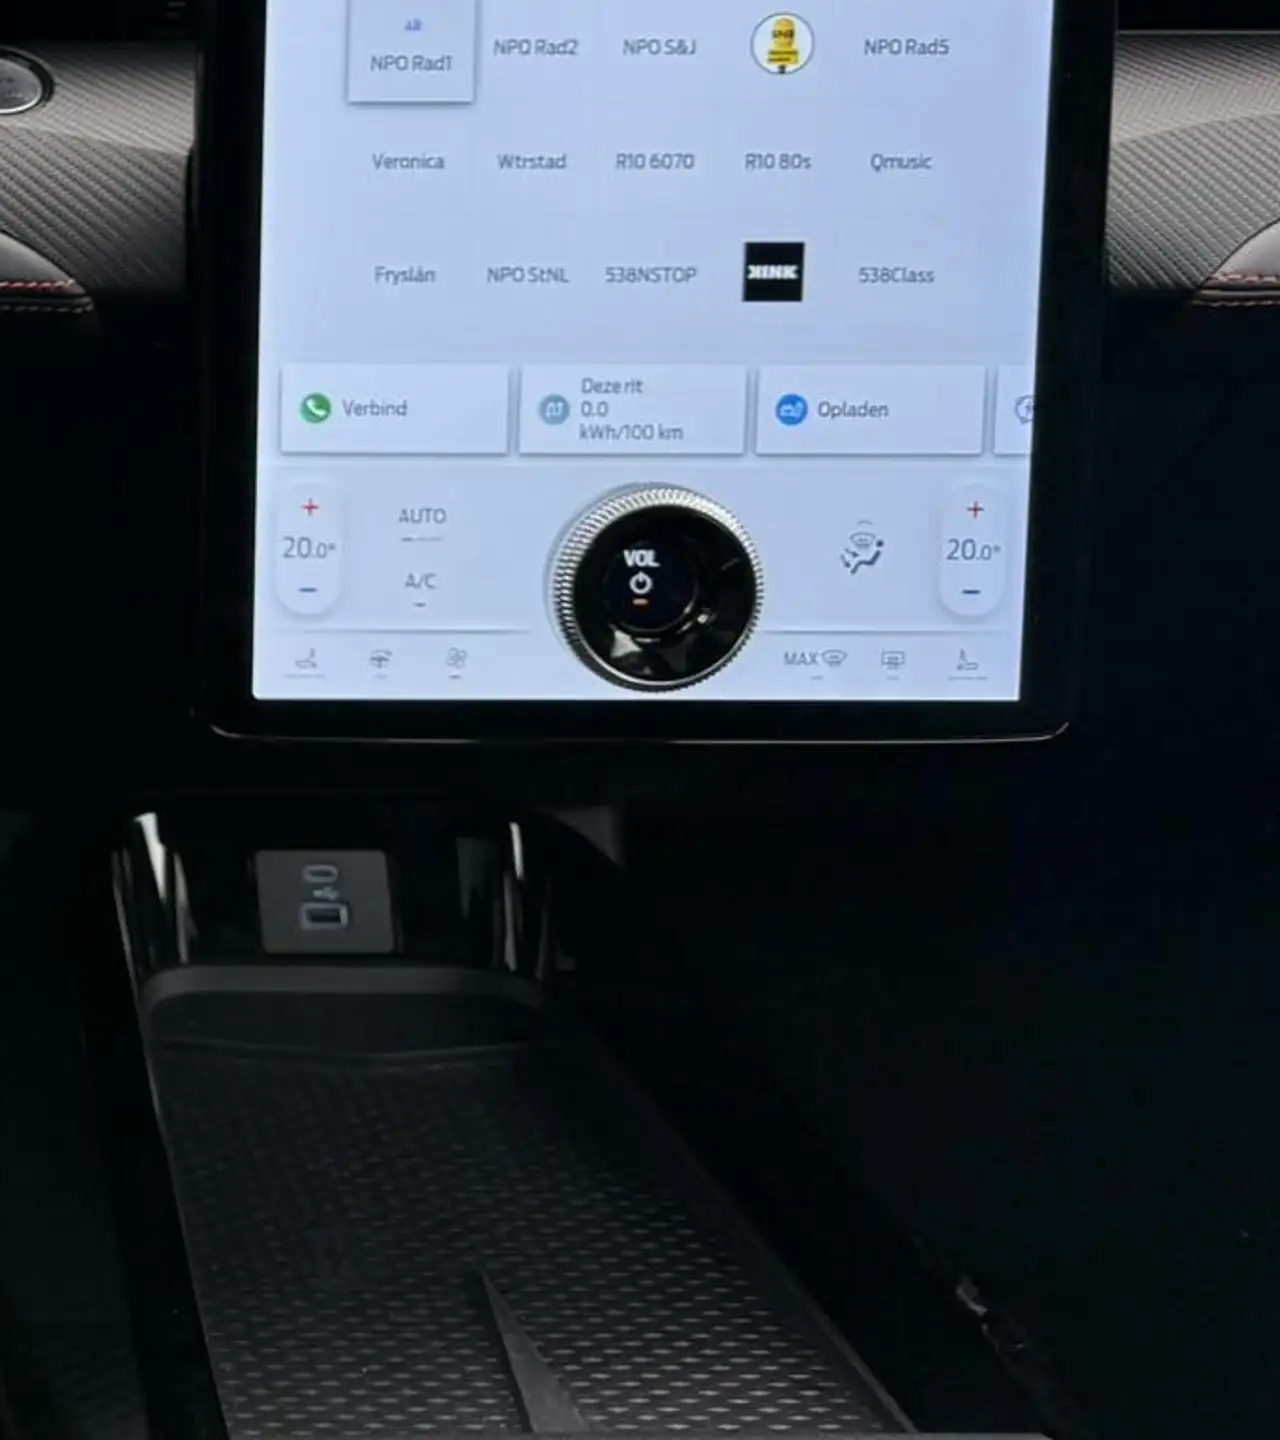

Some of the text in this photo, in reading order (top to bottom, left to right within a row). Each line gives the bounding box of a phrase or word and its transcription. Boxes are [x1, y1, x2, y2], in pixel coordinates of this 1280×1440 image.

[493, 38, 579, 56] NPO Rad2
[622, 38, 697, 57] NPO S&J
[864, 38, 950, 56] NPO Rad5
[370, 55, 452, 73] NPO Rad1
[371, 152, 446, 170] Veronica
[497, 152, 568, 170] Wtrstad
[615, 152, 696, 170] R10 6070
[745, 152, 813, 170] R10 80s
[869, 152, 933, 172] Qmusic
[486, 266, 570, 284] NPO StNL
[604, 266, 697, 284] 538NSTOP
[746, 264, 800, 280] KINK
[858, 266, 935, 284] 538Class
[579, 377, 644, 395] Deze rit
[342, 398, 408, 418] Verbind
[580, 400, 610, 418] 0.0
[817, 400, 890, 420] Opladen
[578, 423, 684, 442] kWh/100 km
[398, 508, 447, 525] AUTO
[623, 549, 661, 568] VOL
[404, 572, 438, 590] A/C
[784, 651, 819, 668] MAX
